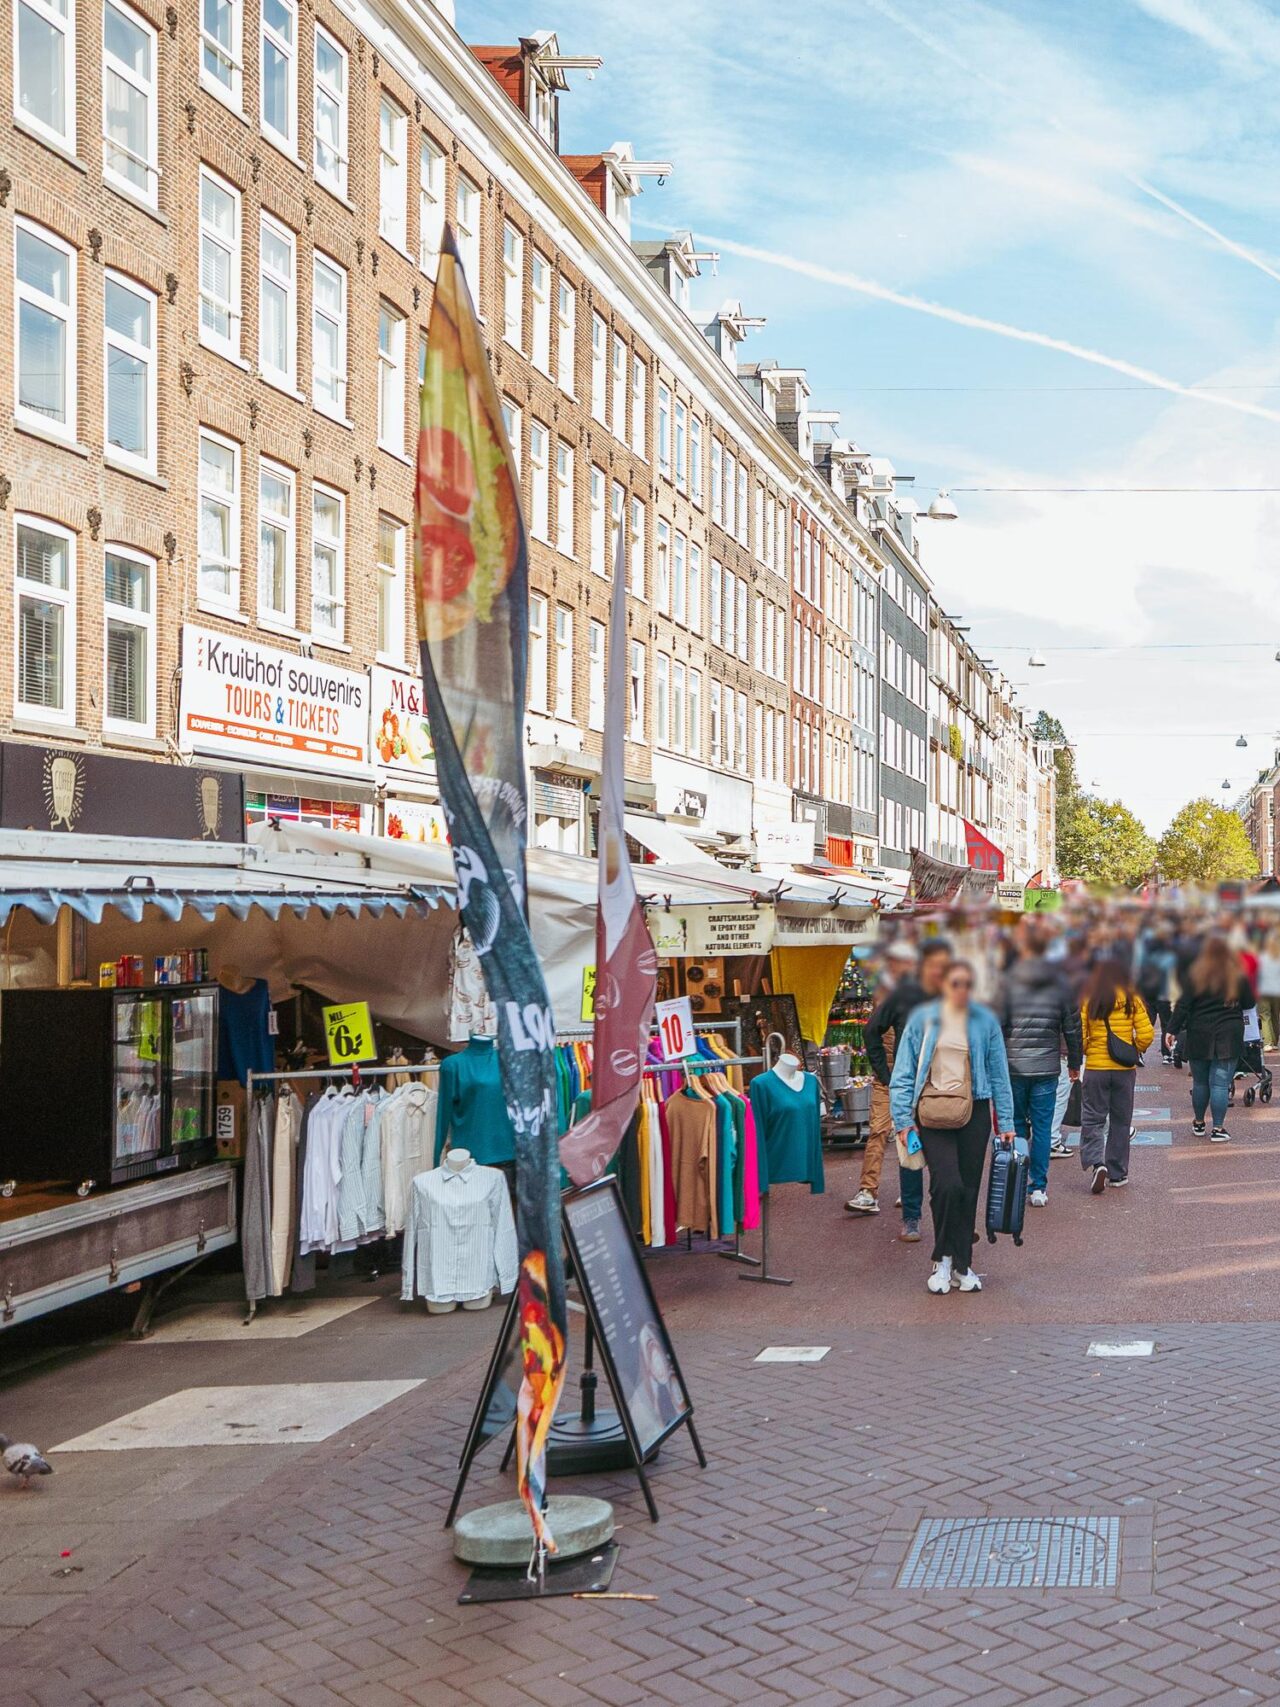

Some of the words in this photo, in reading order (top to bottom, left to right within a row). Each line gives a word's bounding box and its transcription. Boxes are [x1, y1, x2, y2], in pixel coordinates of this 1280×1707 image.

[208, 639, 284, 688] Kruithof
[288, 669, 362, 708] souvenirs
[225, 684, 272, 723] TOURS
[275, 697, 286, 725] &
[288, 698, 340, 735] TICKETS
[708, 914, 759, 922] CRAFTSMANSHIP
[739, 923, 756, 931] RESIN
[705, 943, 731, 951] NATURAL
[732, 942, 762, 950] ELEMENTS
[218, 1107, 231, 1137] 1759
